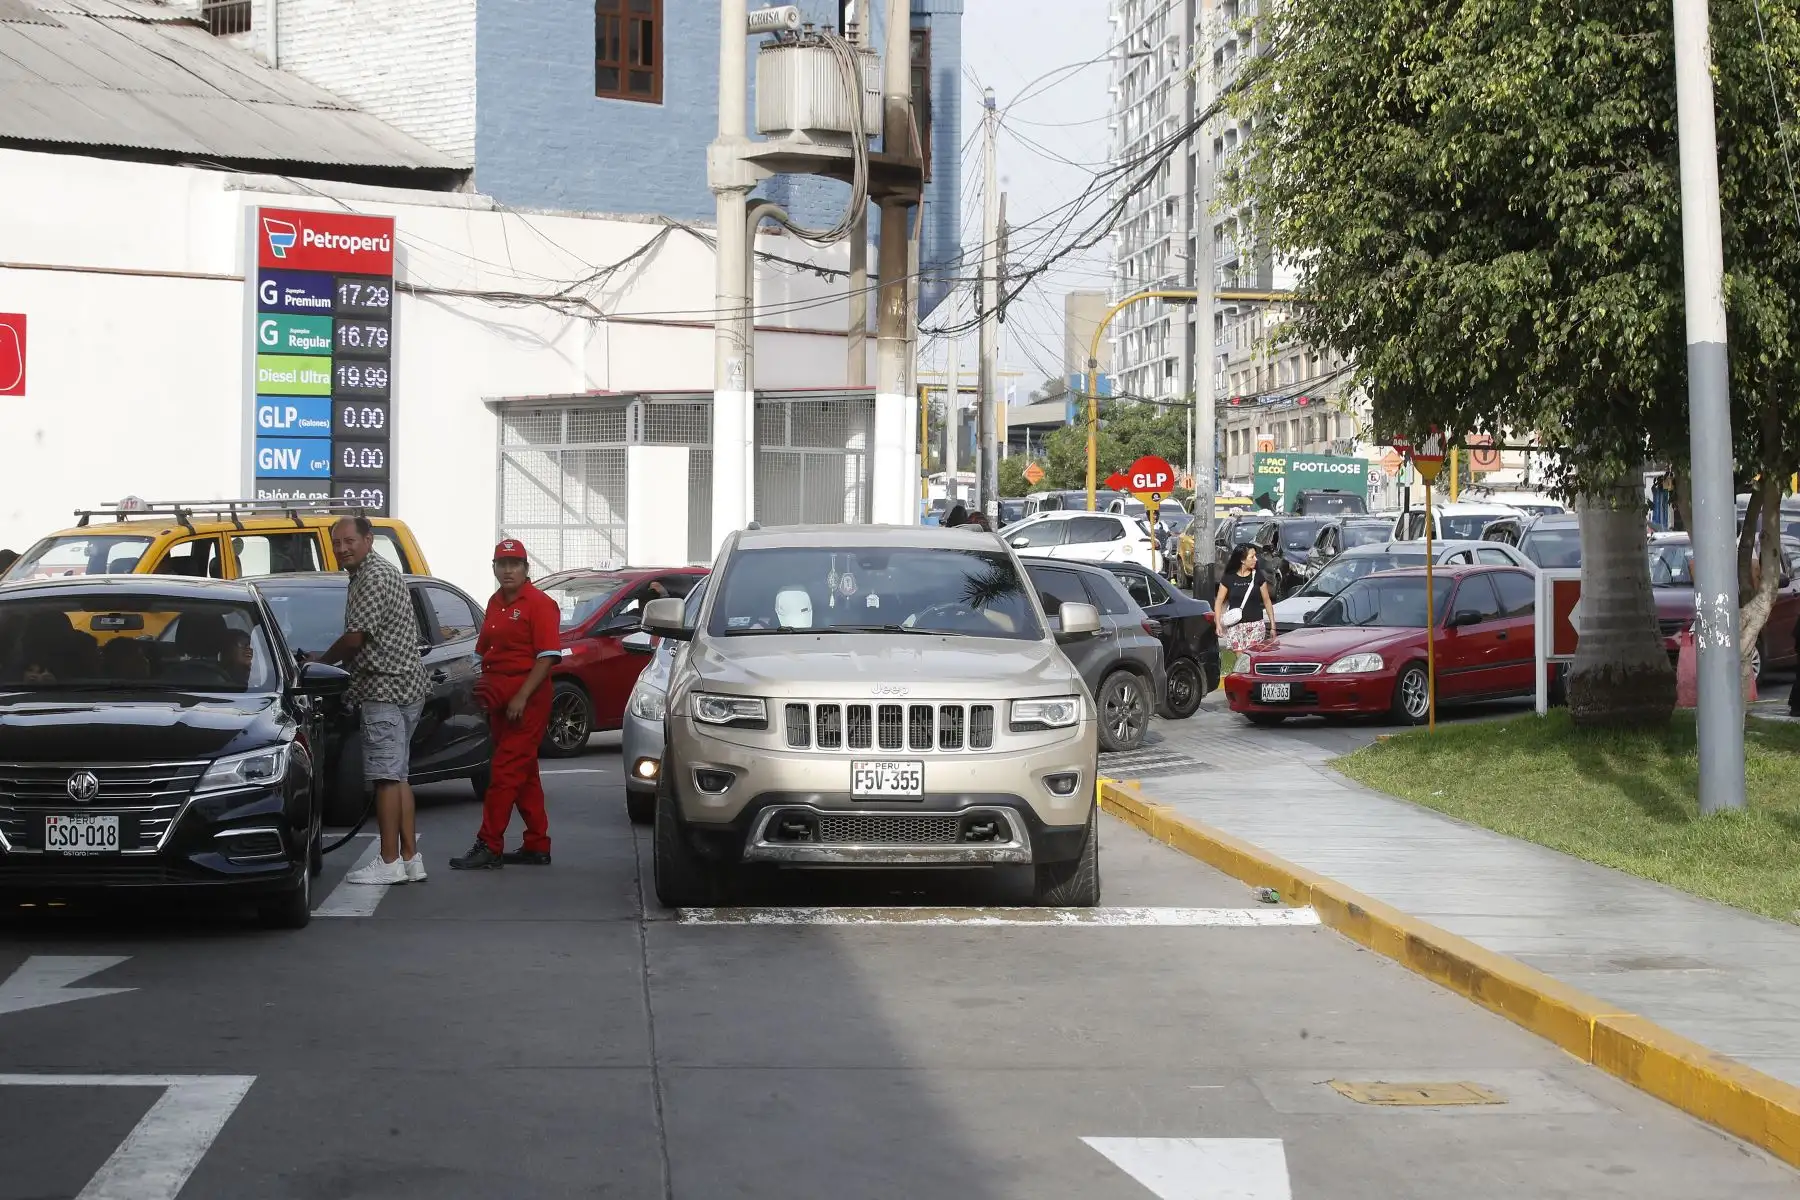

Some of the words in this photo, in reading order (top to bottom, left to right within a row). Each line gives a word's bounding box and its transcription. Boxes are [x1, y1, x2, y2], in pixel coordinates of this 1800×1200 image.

[303, 229, 390, 254] Petroperú
[260, 280, 278, 305] G
[285, 295, 331, 308] Premium
[338, 283, 389, 307] 17.29
[260, 320, 278, 345] G
[289, 335, 331, 349] Regular
[338, 325, 389, 348] 16.79
[259, 369, 297, 383] Diesel
[300, 369, 330, 385] Ultra
[337, 366, 388, 388] 19.99
[258, 406, 298, 428] GLP
[299, 419, 330, 428] (Galones)
[343, 406, 384, 428] 0.00
[258, 448, 301, 470] GNV
[343, 447, 384, 468] 0.00
[1293, 462, 1361, 474] FOOTLOOSE
[1132, 472, 1167, 488] GLP
[258, 488, 290, 500] Balón
[291, 489, 306, 500] de
[308, 492, 329, 505] gas
[343, 488, 384, 509] 0.00
[871, 681, 909, 697] Jeep
[875, 762, 900, 770] PERU
[855, 770, 919, 790] F5V-355
[69, 817, 96, 825] PERU
